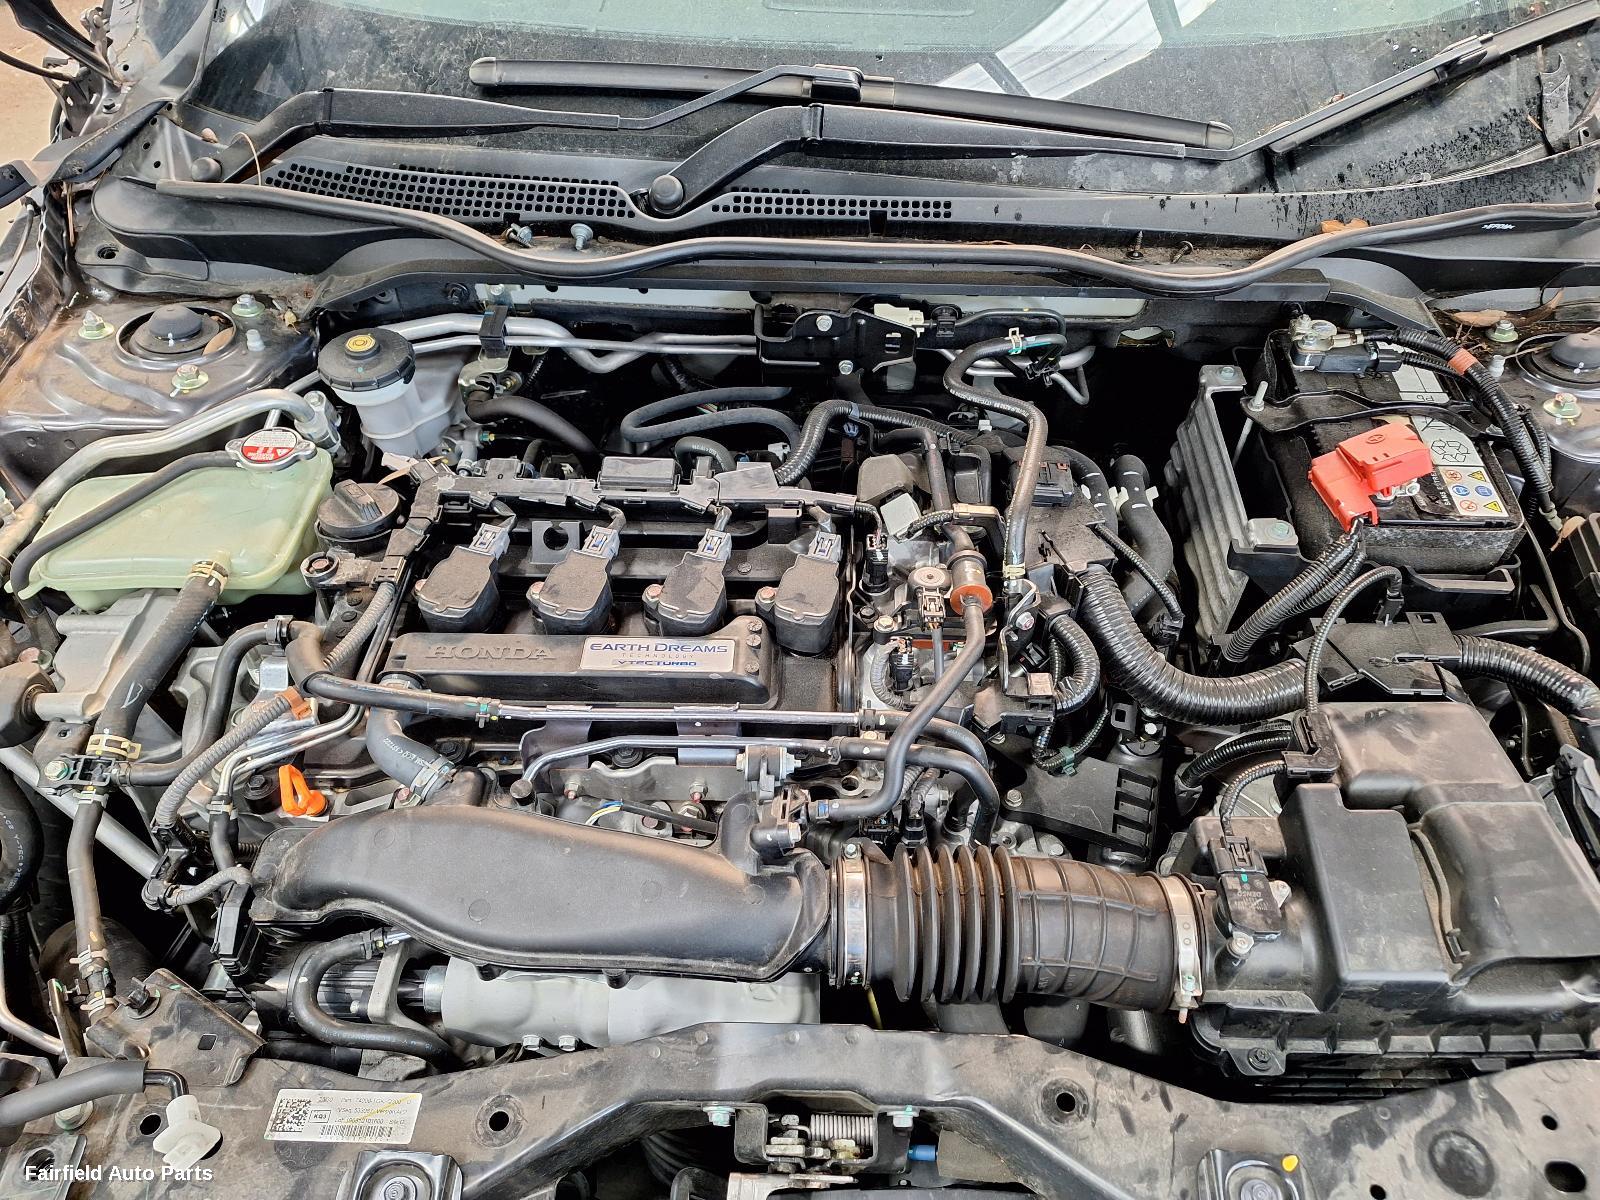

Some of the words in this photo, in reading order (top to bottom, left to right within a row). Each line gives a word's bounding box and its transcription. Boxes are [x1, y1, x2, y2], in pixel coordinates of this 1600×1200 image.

[1439, 490, 1452, 506] SANS
[425, 645, 556, 660] HONDA
[590, 643, 650, 651] EARTH
